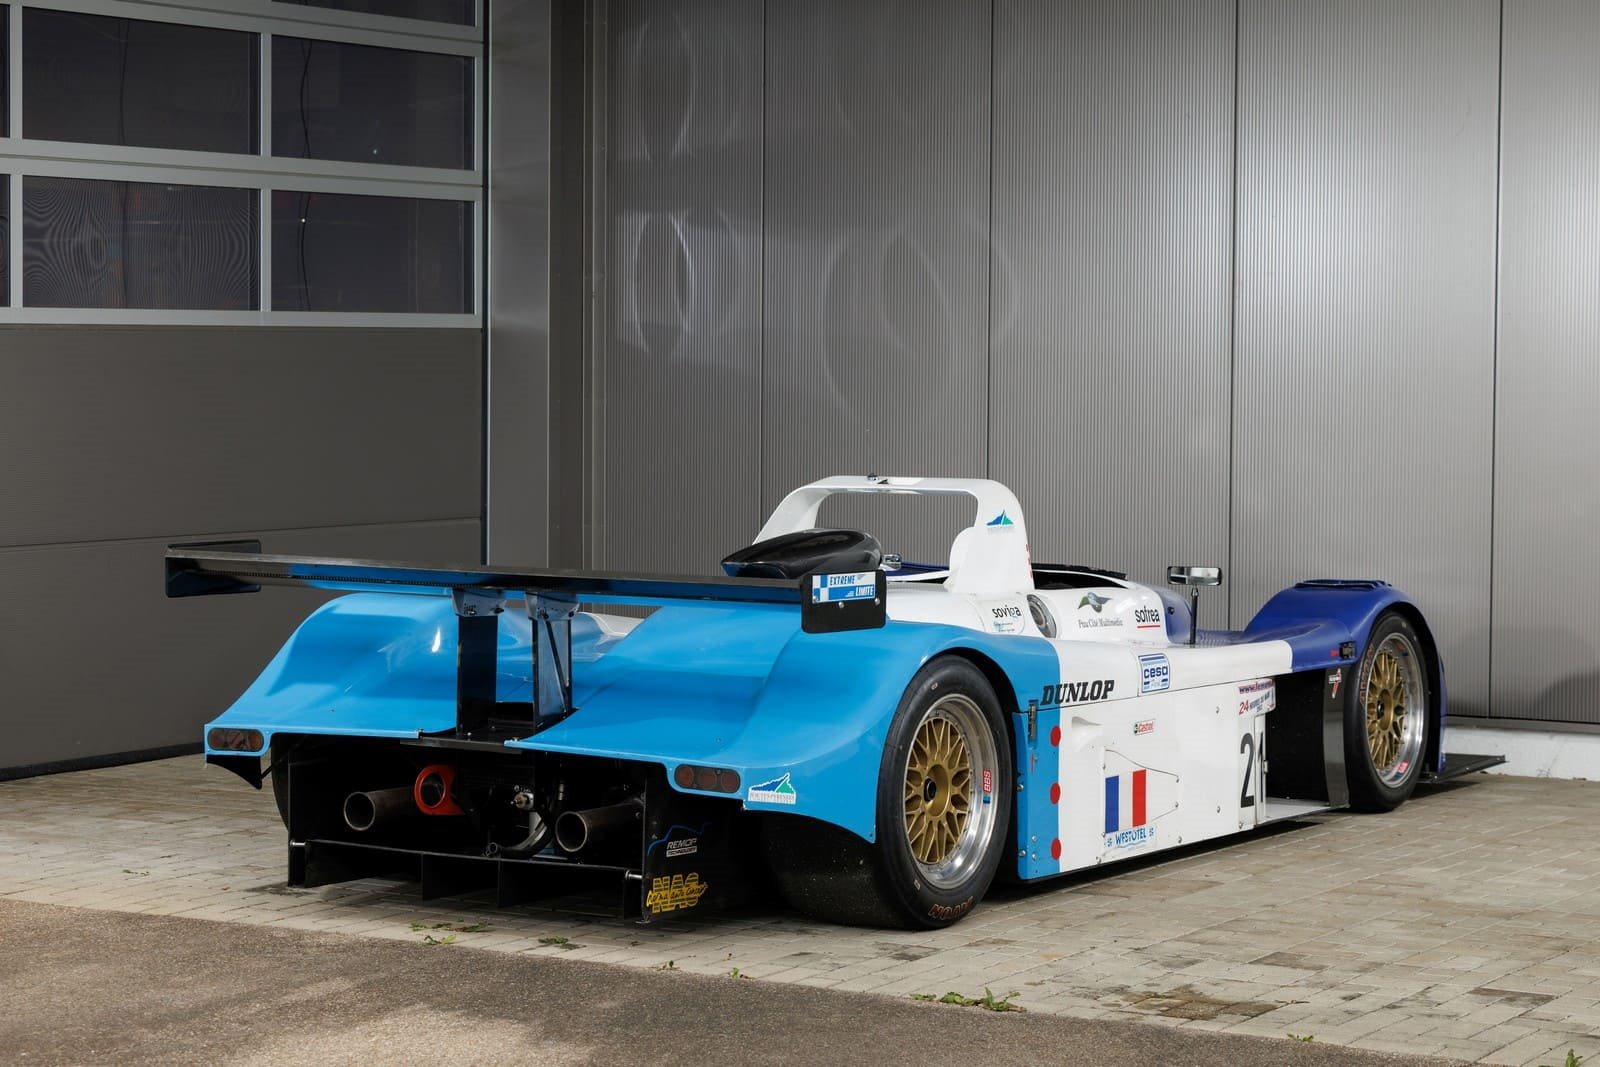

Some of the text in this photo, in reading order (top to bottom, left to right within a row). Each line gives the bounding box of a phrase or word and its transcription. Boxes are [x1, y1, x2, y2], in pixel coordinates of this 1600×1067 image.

[829, 575, 856, 586] EXTREME
[855, 585, 875, 597] LIMITE
[1134, 604, 1160, 623] sofrea
[1143, 665, 1169, 680] cesa
[1039, 679, 1115, 706] DUNLOP
[1238, 699, 1249, 716] 24
[983, 770, 991, 792] BBS
[1115, 827, 1147, 845] WESTOTEL
